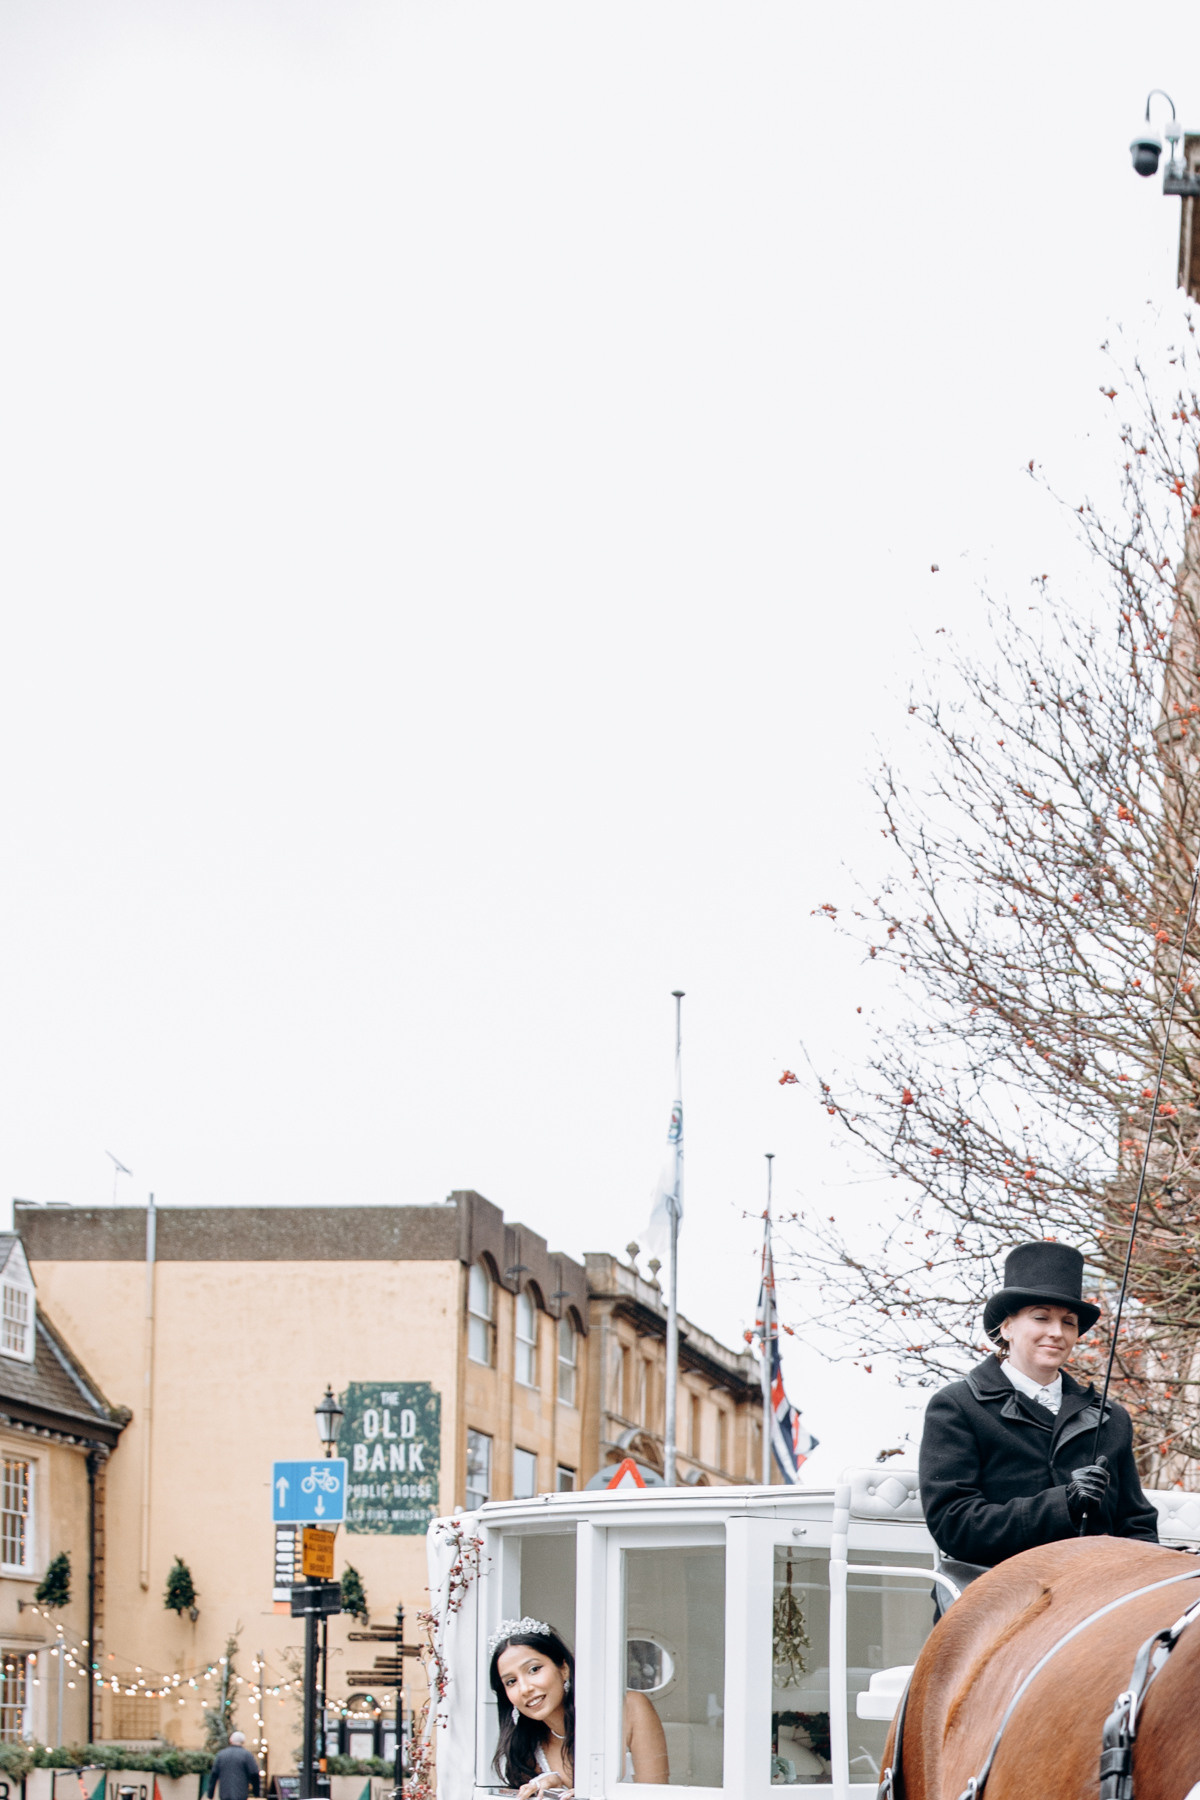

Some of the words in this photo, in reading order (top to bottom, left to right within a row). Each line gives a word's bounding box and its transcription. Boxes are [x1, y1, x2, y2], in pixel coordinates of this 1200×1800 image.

[381, 1391, 399, 1406] THE
[363, 1408, 417, 1439] OLD
[353, 1443, 426, 1472] BANK
[346, 1484, 390, 1499] PUBLIC
[393, 1484, 432, 1499] HOUSE
[275, 1530, 294, 1583] ROUTE
